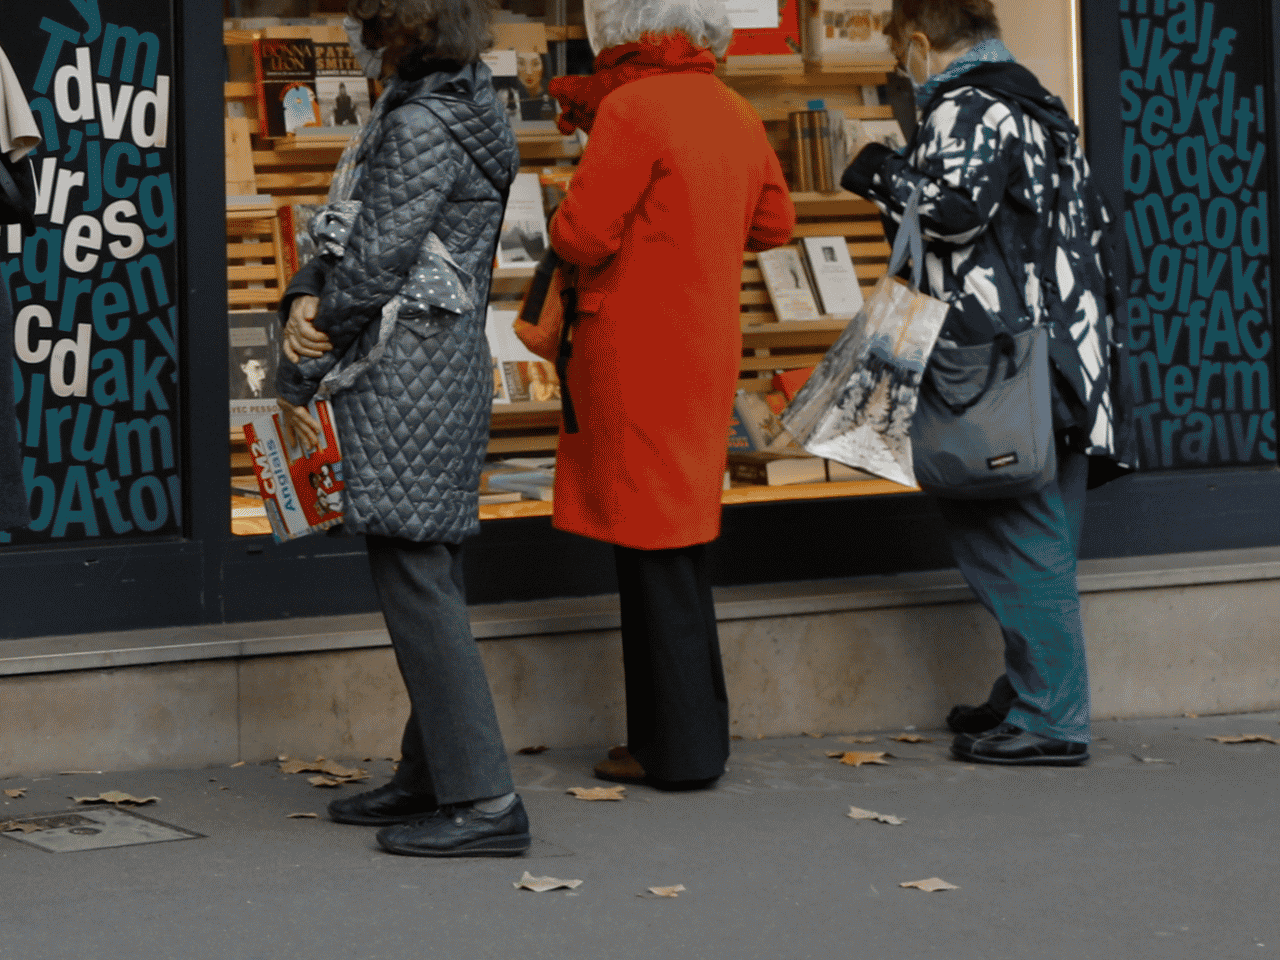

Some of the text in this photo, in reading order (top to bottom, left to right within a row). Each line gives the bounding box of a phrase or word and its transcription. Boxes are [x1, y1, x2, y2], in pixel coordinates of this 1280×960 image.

[53, 47, 170, 148] dvd
[14, 304, 92, 398] cd
[250, 438, 277, 496] CM2
[266, 437, 296, 512] Anglais
